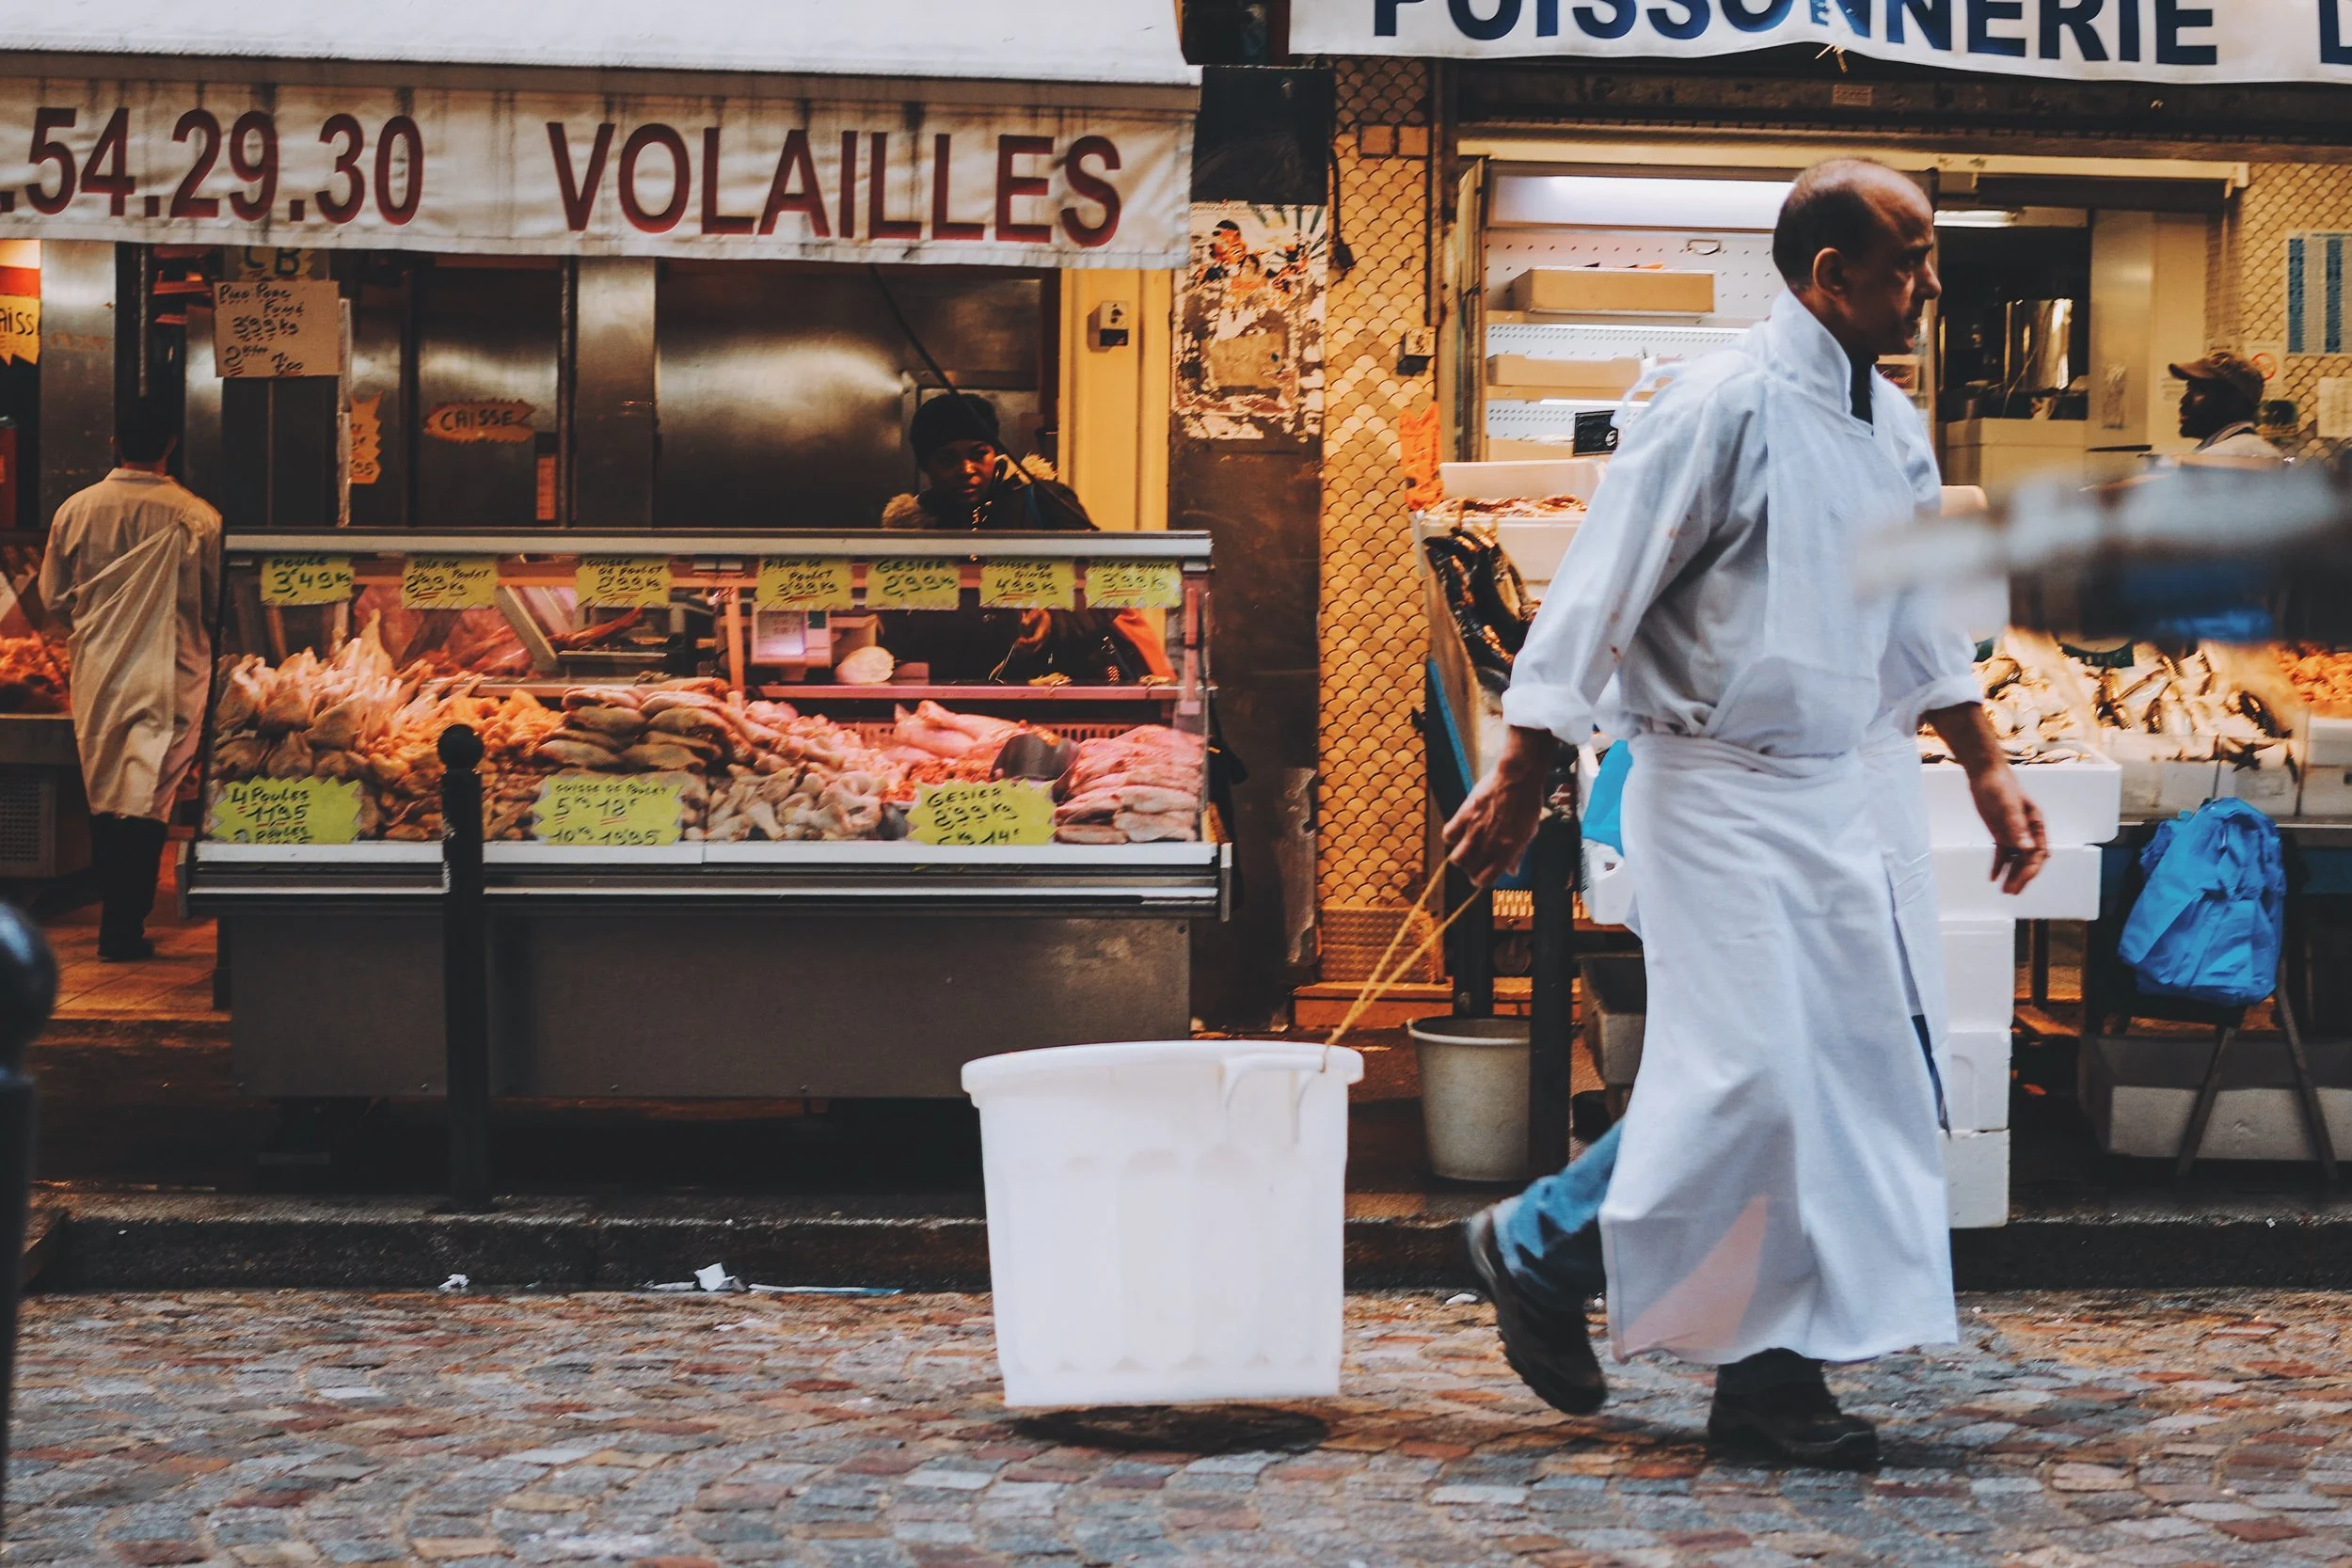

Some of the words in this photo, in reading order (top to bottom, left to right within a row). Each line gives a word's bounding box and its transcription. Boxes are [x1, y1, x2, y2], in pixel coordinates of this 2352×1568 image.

[547, 122, 1122, 247] VOLAILLES
[230, 787, 247, 805] 4
[553, 797, 571, 816] 5
